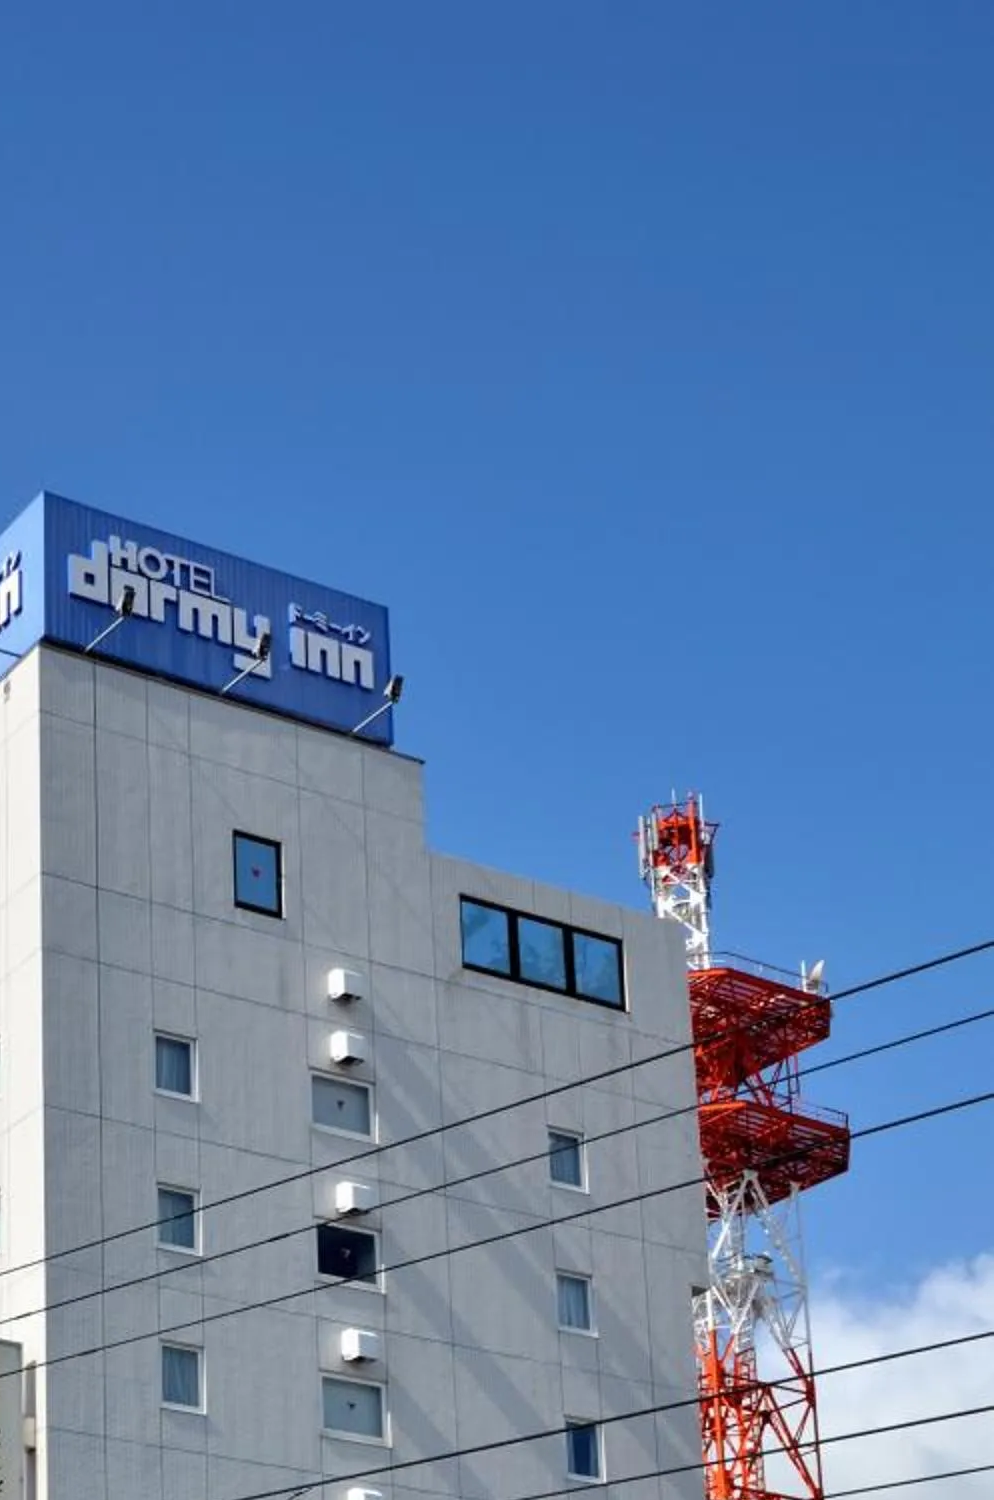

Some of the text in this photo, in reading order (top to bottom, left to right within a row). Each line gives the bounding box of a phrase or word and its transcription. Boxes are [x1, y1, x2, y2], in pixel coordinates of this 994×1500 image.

[109, 534, 230, 603] HOTEL
[68, 539, 375, 690] dormy inn
[288, 602, 372, 645] ドーミーイン
